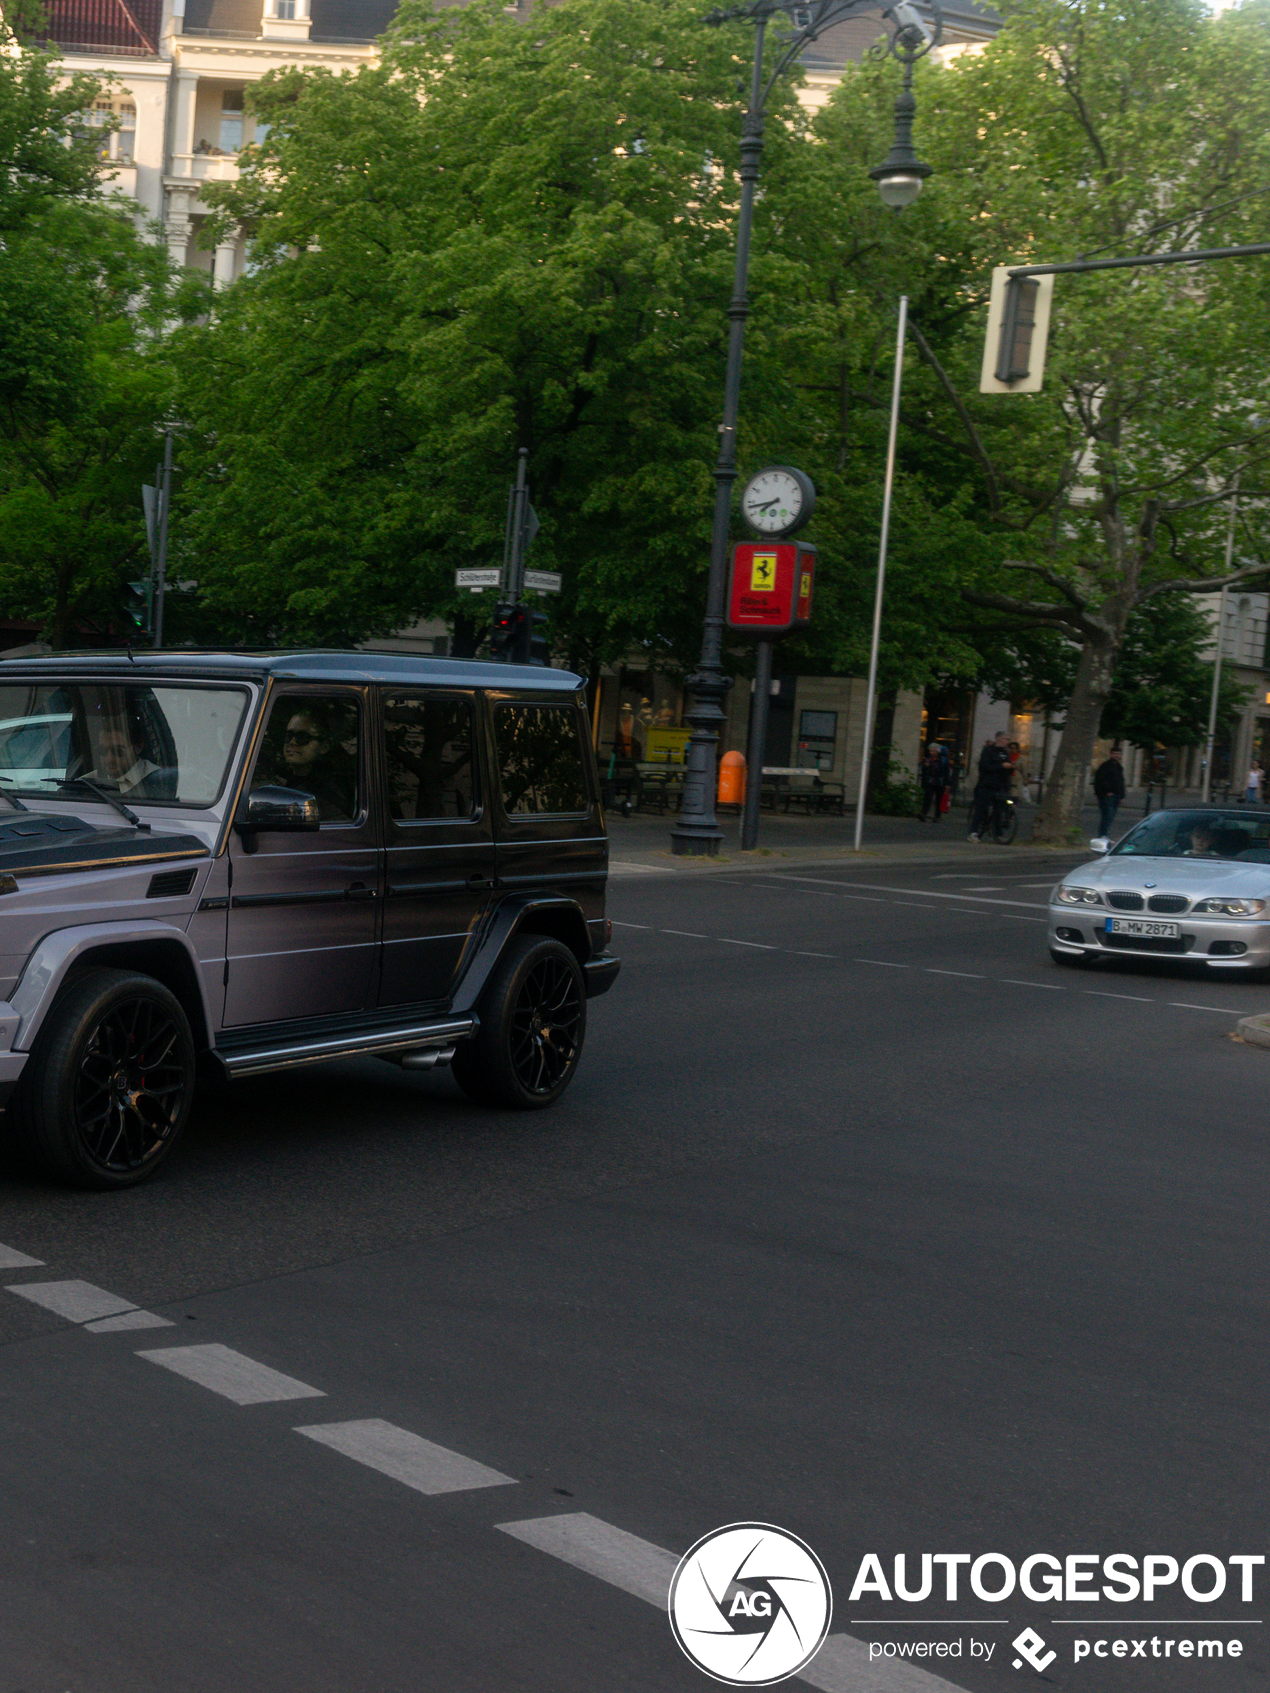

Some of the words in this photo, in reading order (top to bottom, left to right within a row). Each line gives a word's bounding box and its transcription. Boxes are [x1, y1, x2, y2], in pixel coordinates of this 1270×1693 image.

[1113, 920, 1120, 932] B
[1127, 922, 1143, 933] MW
[1145, 924, 1175, 936] 2871
